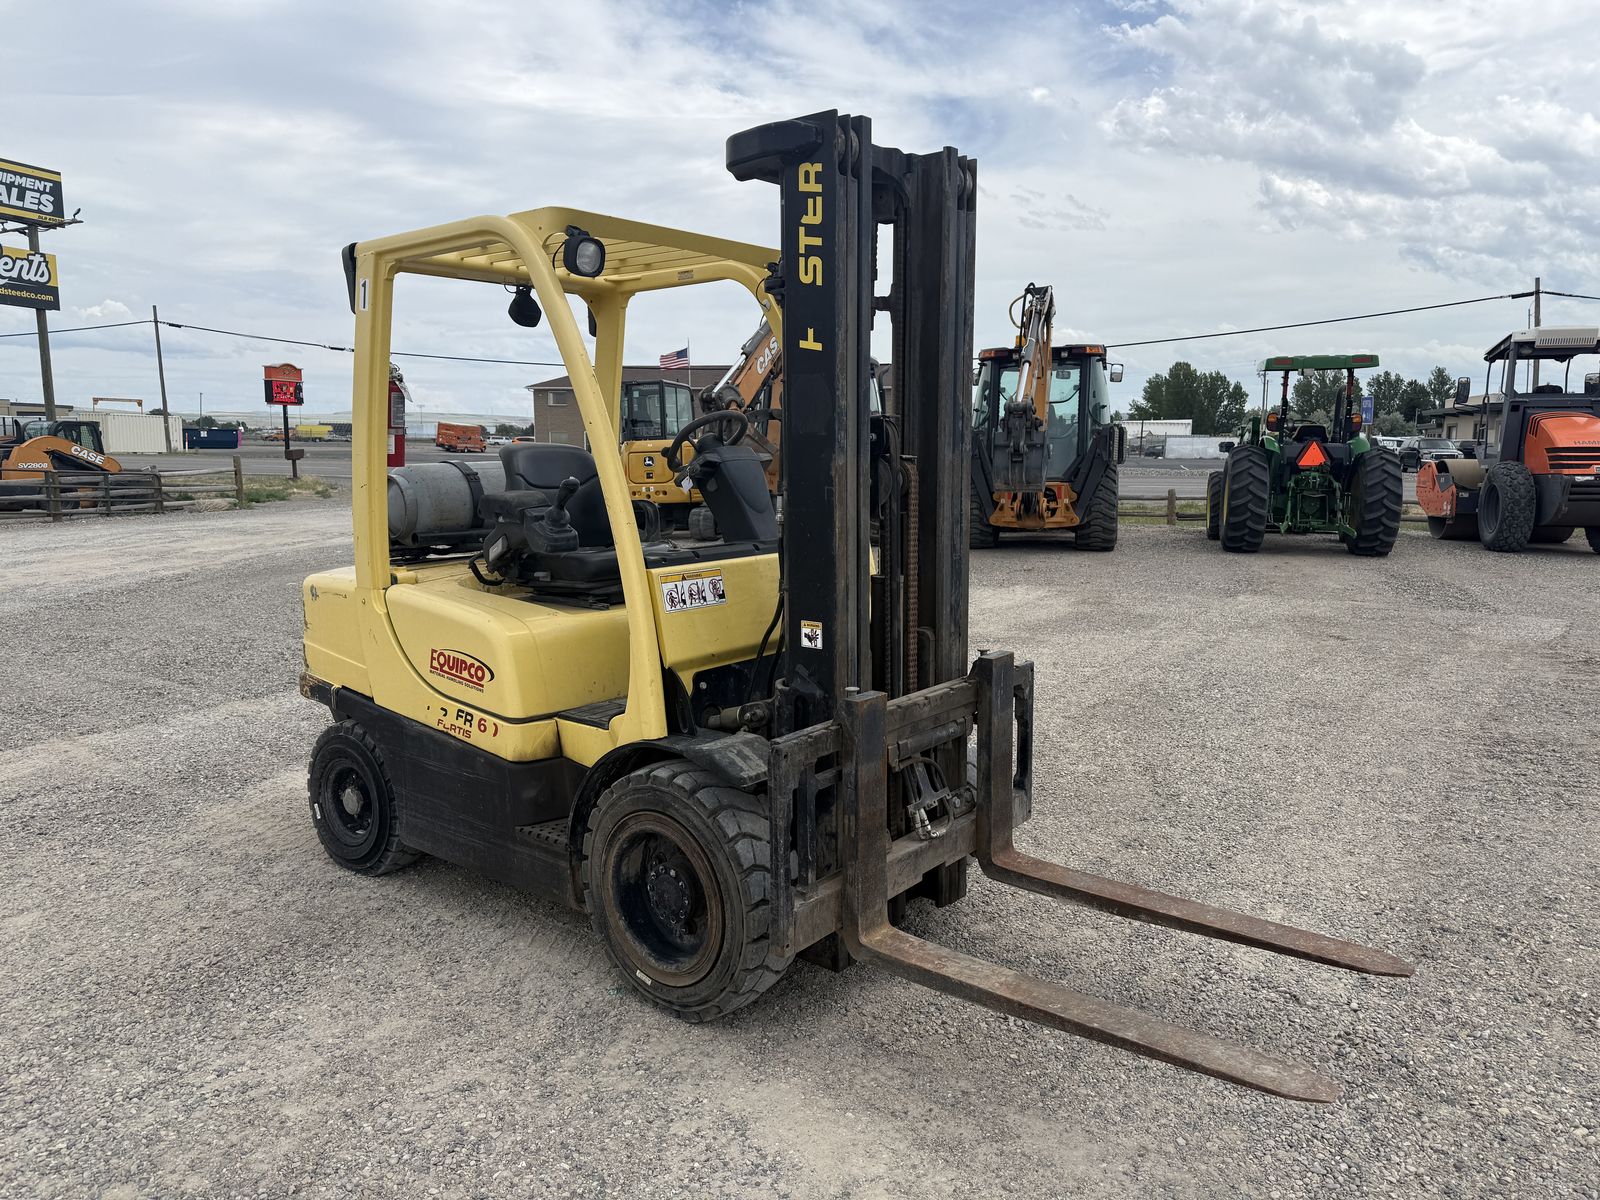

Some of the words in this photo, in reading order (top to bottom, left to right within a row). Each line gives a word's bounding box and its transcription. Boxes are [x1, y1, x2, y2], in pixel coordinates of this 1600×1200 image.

[361, 280, 368, 309] 1
[756, 336, 779, 375] CAS
[70, 446, 105, 465] CASE
[430, 648, 485, 682] EQUIPCO
[464, 682, 485, 694] SOLUTIONS
